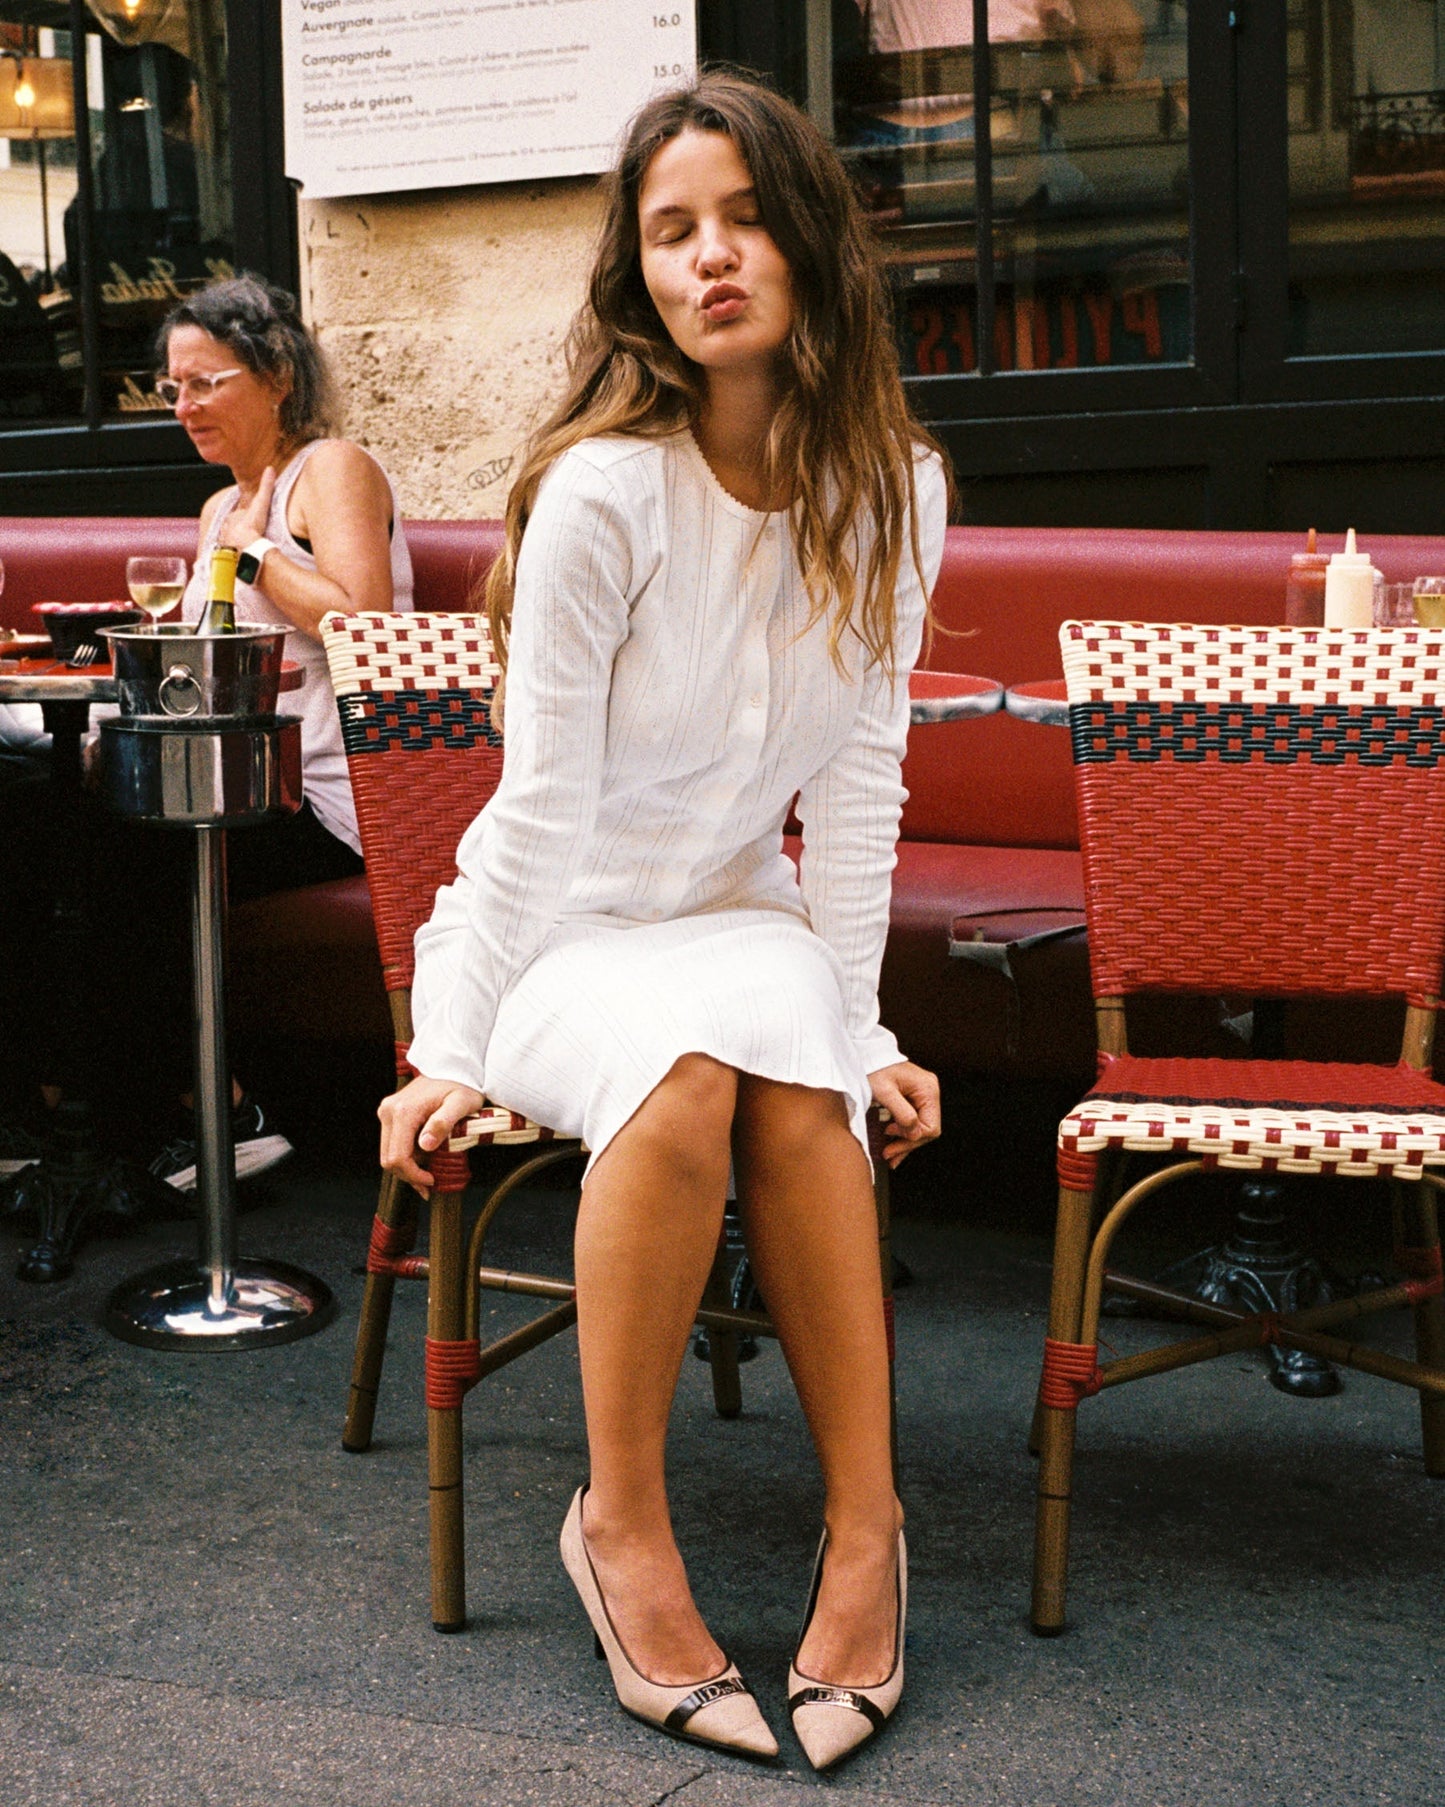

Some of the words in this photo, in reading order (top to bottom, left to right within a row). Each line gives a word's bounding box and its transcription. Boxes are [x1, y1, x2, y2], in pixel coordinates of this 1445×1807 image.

[302, 0, 341, 13] Vegan
[302, 17, 374, 33] Auvergnate
[652, 13, 681, 28] 16.0
[302, 46, 392, 67] Campagnarde
[654, 63, 682, 78] 15.0
[303, 96, 346, 115] Salade
[349, 95, 365, 109] de
[369, 94, 413, 111] gésiers
[703, 1684, 737, 1701] Dior
